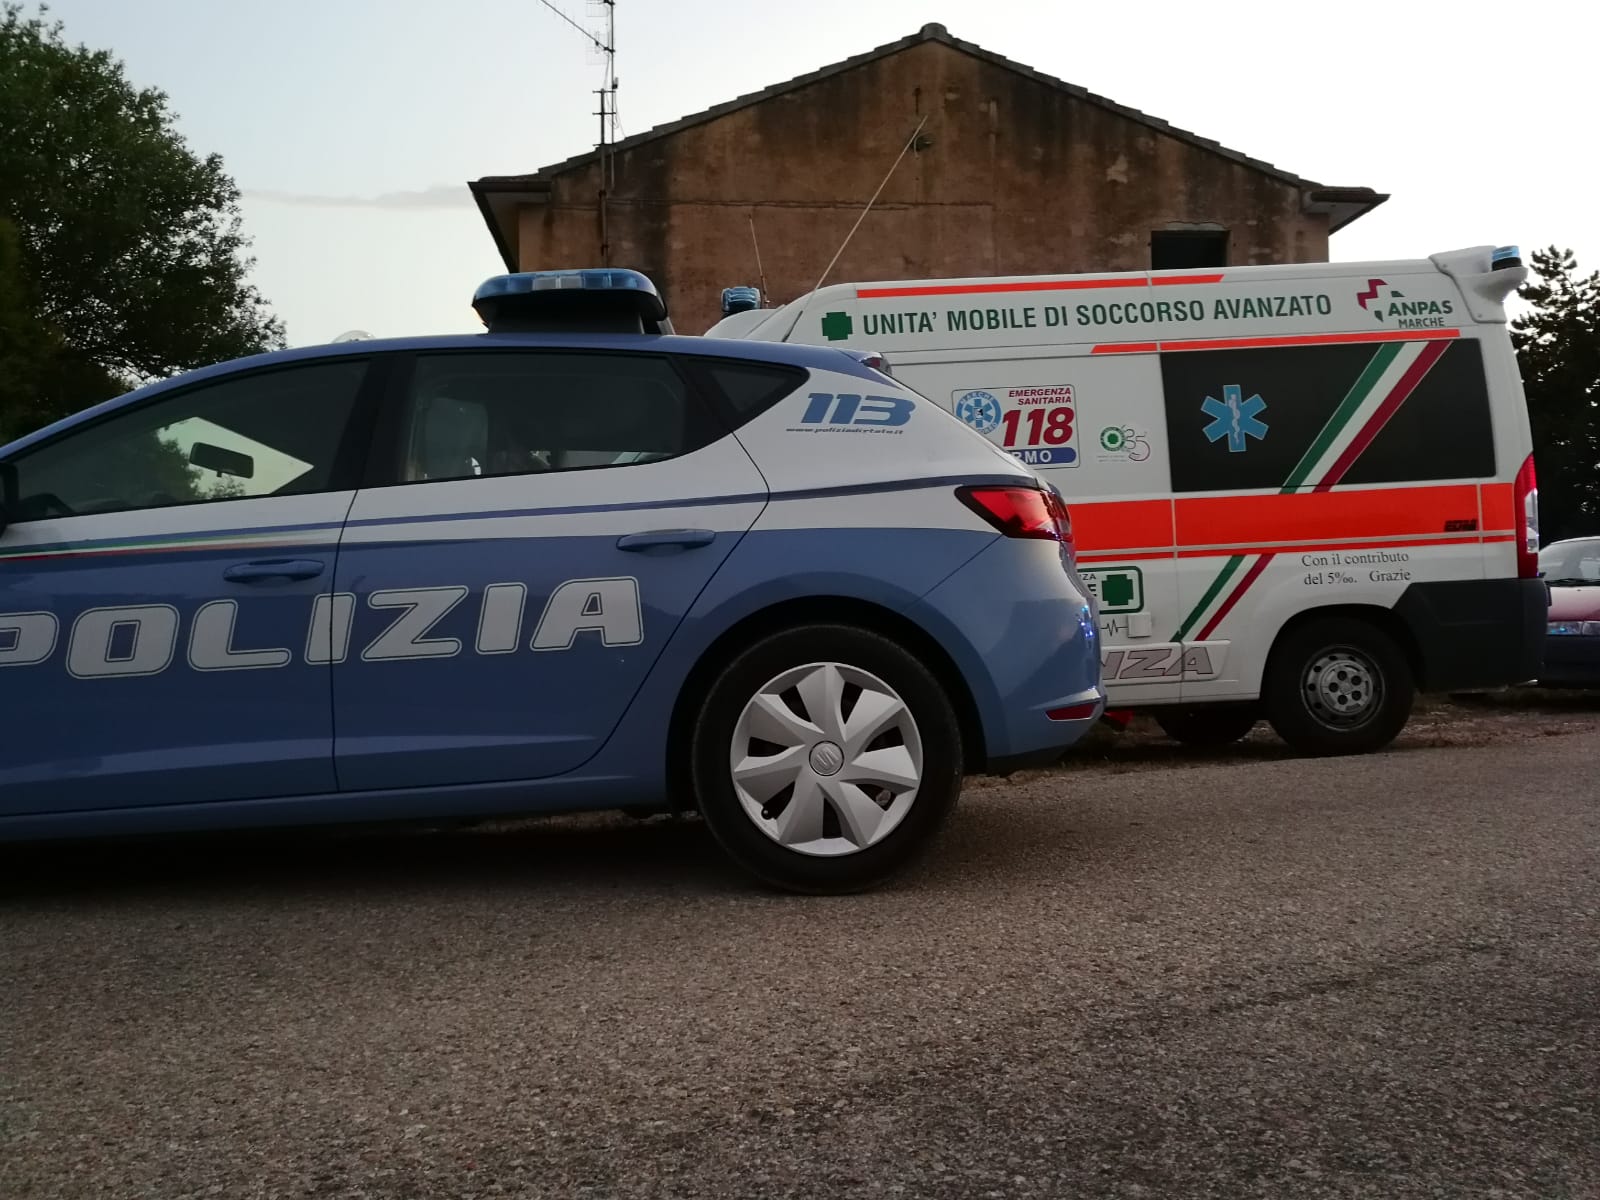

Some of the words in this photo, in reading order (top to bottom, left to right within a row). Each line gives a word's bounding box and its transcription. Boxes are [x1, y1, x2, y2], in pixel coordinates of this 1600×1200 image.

[863, 311, 938, 335] UNITA'
[947, 307, 1037, 331] MOBILE
[1045, 306, 1068, 327] DI
[1076, 299, 1205, 325] SOCCORSO
[1213, 294, 1332, 320] AVANZATO
[1388, 300, 1453, 316] ANPAS
[1398, 317, 1445, 328] MARCHE
[1008, 387, 1072, 398] EMERGENZA
[1017, 396, 1073, 406] SANITARIA
[800, 393, 916, 427] 113
[1001, 406, 1075, 447] 118
[1301, 554, 1328, 567] Con
[1332, 552, 1342, 566] il
[1344, 551, 1409, 565] contributo
[1079, 573, 1097, 581] ZA
[1303, 572, 1323, 585] del
[1369, 569, 1412, 583] Grazie
